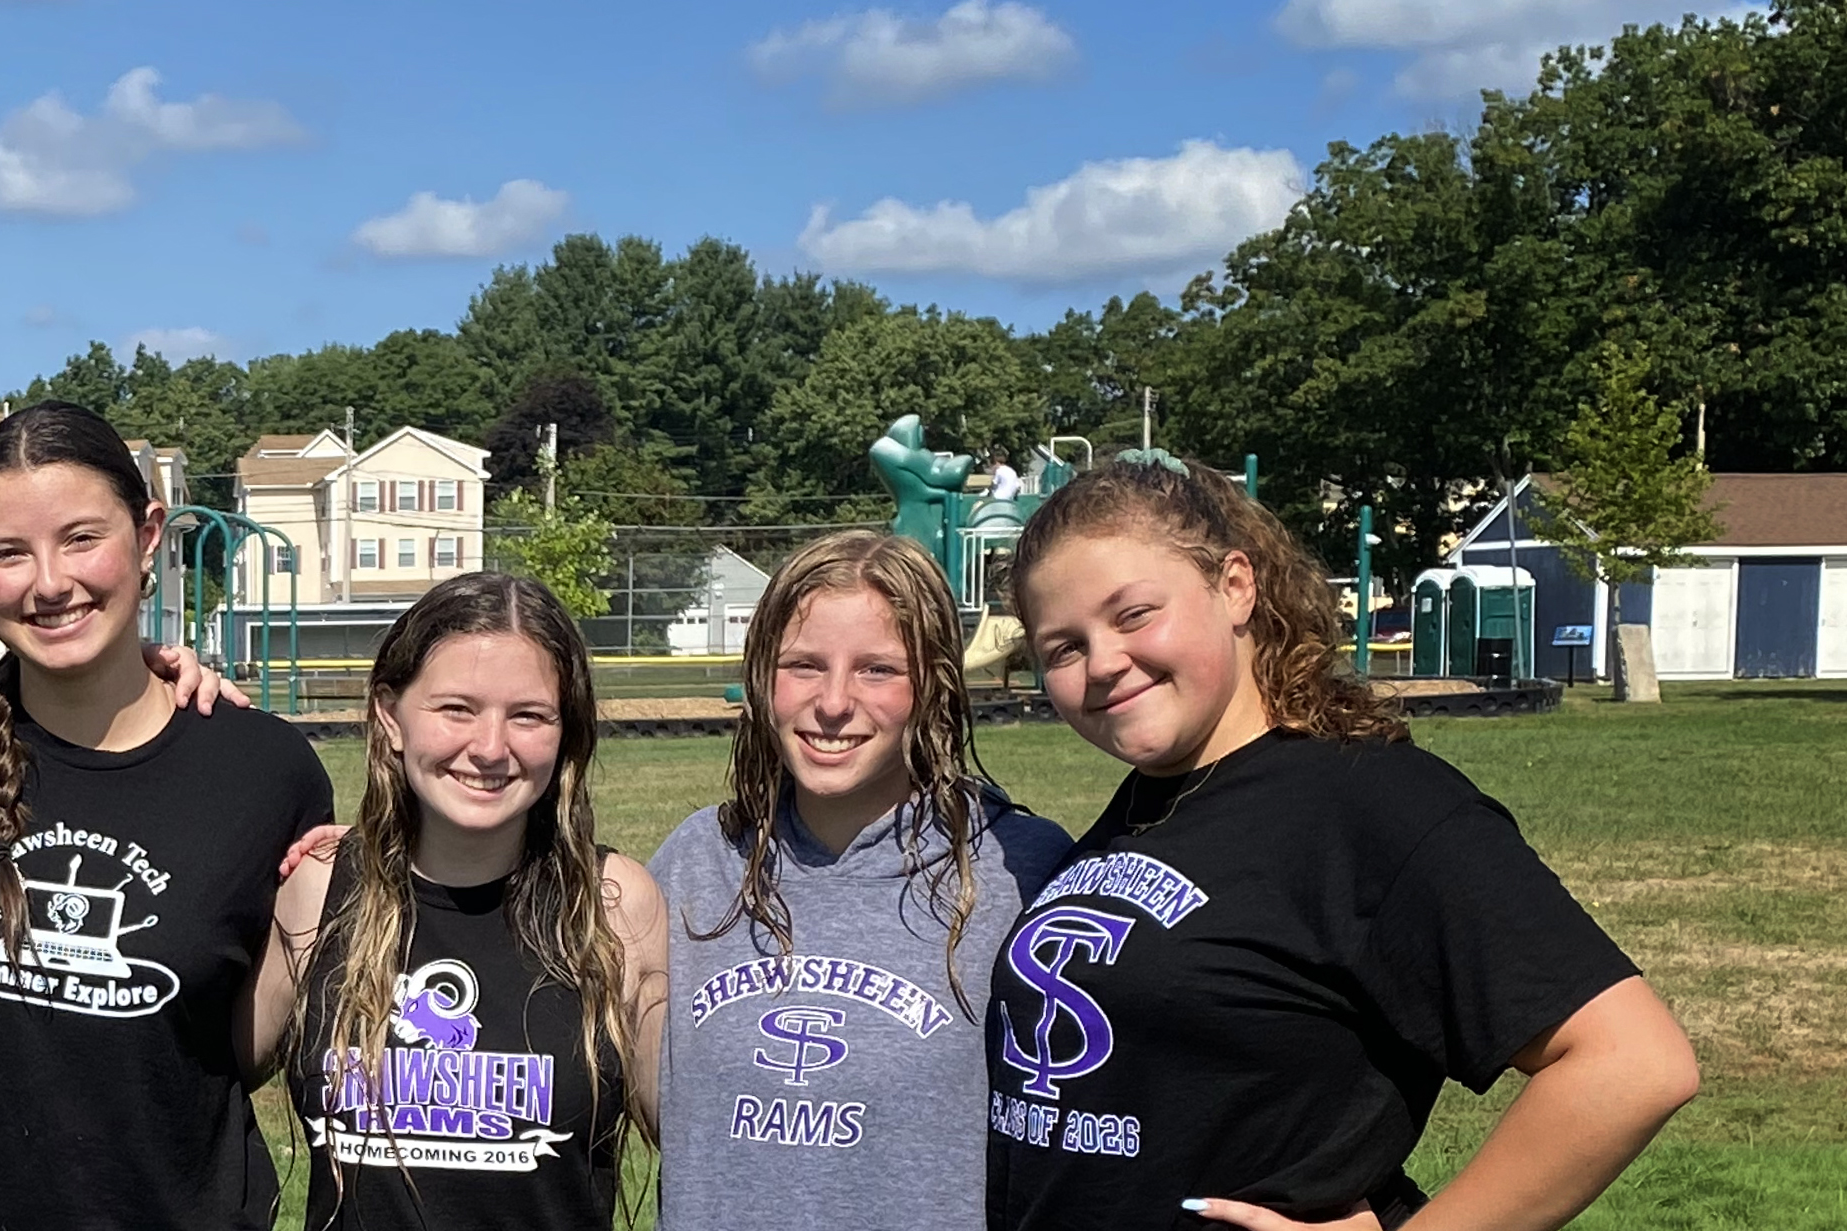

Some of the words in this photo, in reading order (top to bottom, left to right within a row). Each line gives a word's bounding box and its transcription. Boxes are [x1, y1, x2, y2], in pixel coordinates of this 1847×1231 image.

[121, 842, 171, 896] Tech
[1025, 852, 1210, 930] AWSHEEN
[63, 975, 158, 1010] Explore
[691, 955, 953, 1039] SHAWSHEEN
[356, 1105, 514, 1139] RAMS
[730, 1095, 866, 1147] RAMS
[1027, 1104, 1060, 1147] OF
[1062, 1110, 1141, 1158] 2026
[339, 1141, 478, 1164] HOMECOMING
[483, 1150, 530, 1164] 2016
